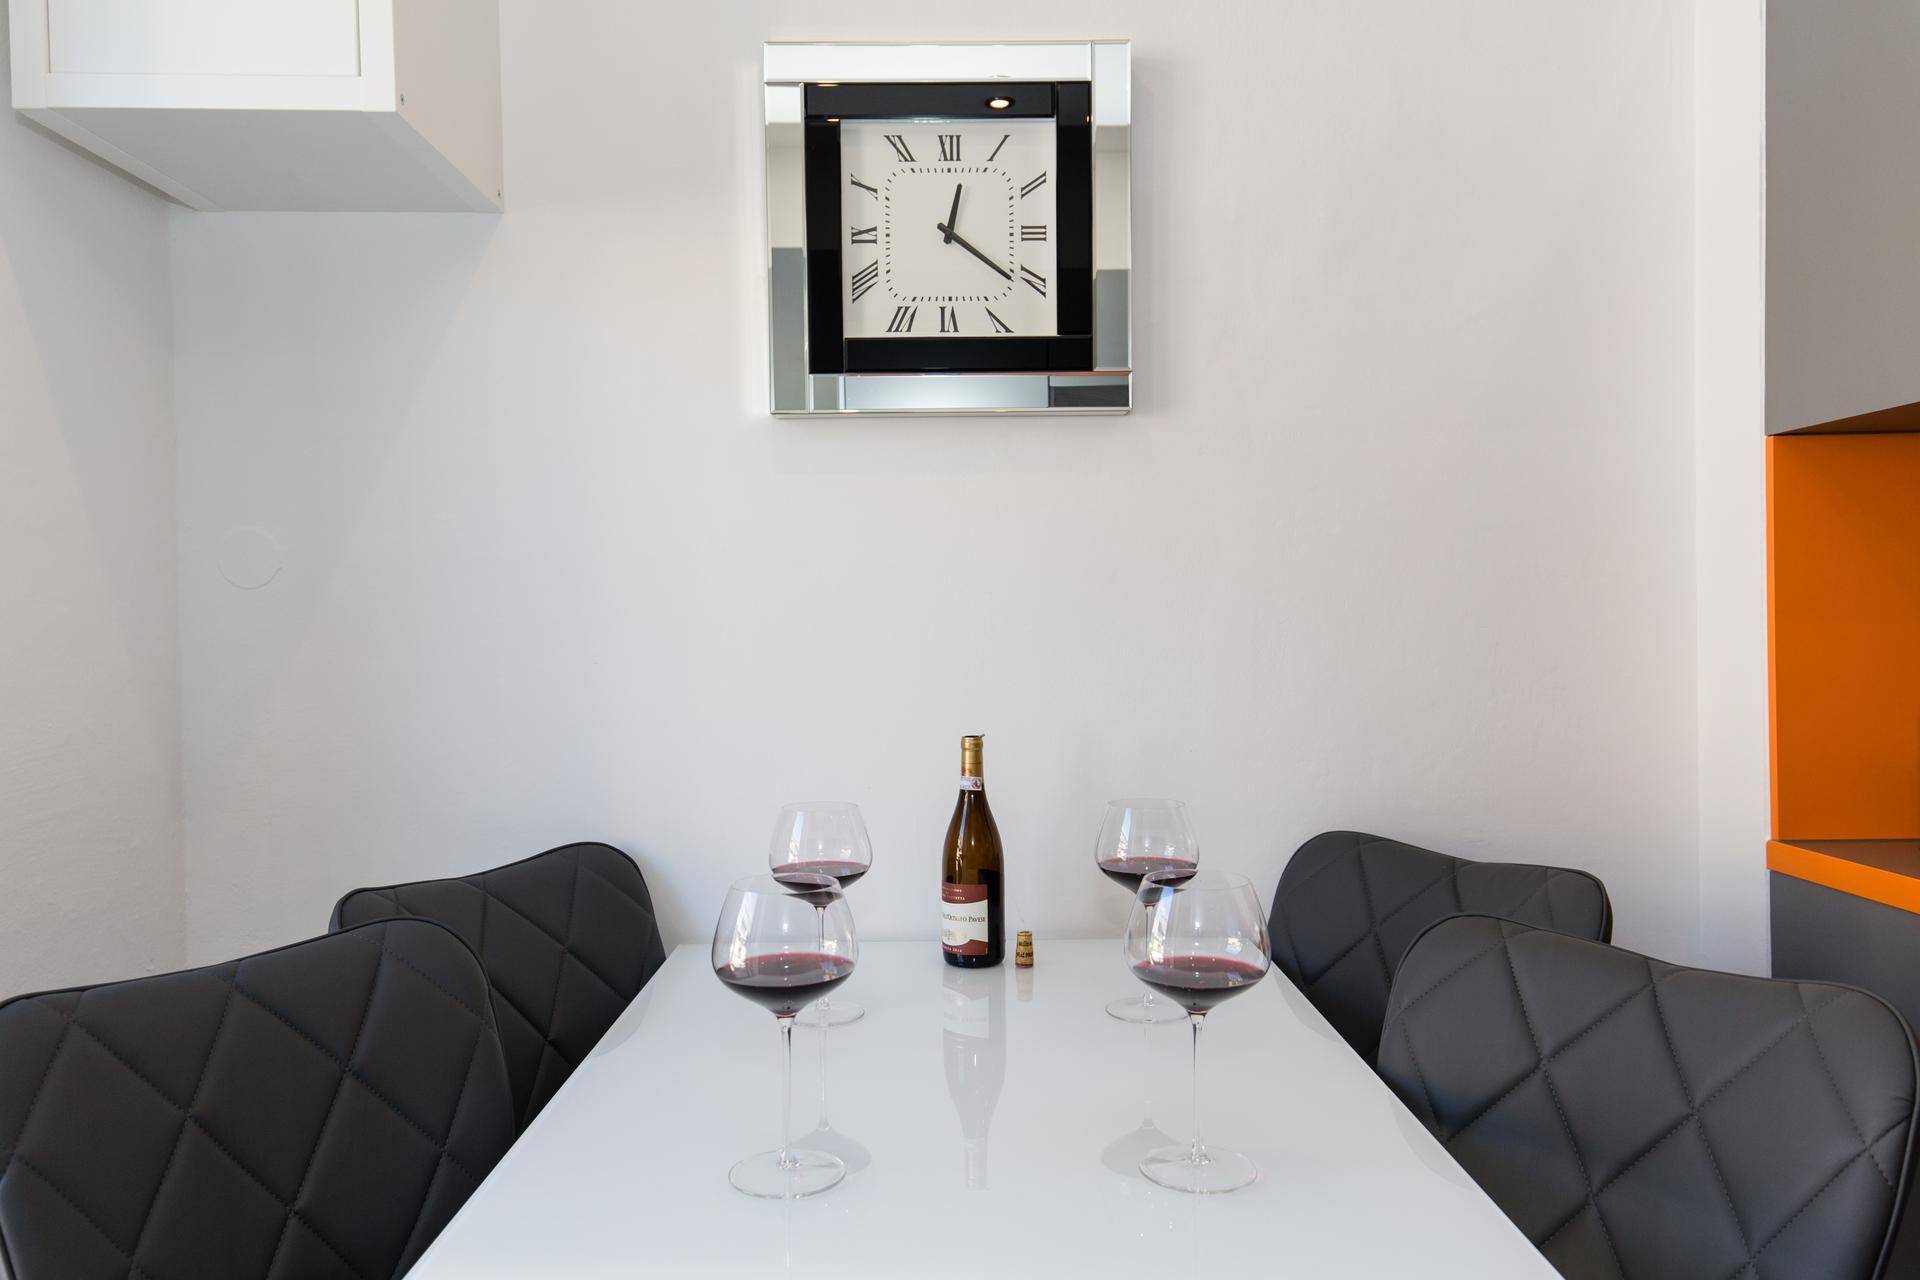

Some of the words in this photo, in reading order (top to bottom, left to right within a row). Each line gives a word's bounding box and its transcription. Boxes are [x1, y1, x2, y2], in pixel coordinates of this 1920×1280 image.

[884, 135, 917, 162] XI
[938, 135, 962, 162] XII
[987, 135, 1011, 162] I
[851, 173, 878, 200] X
[1021, 171, 1046, 199] II
[851, 226, 878, 245] IX
[1021, 225, 1047, 242] III
[852, 259, 878, 304] VIII
[1021, 264, 1046, 298] IV
[886, 306, 918, 332] VII
[939, 306, 959, 332] VI
[985, 306, 1014, 333] V
